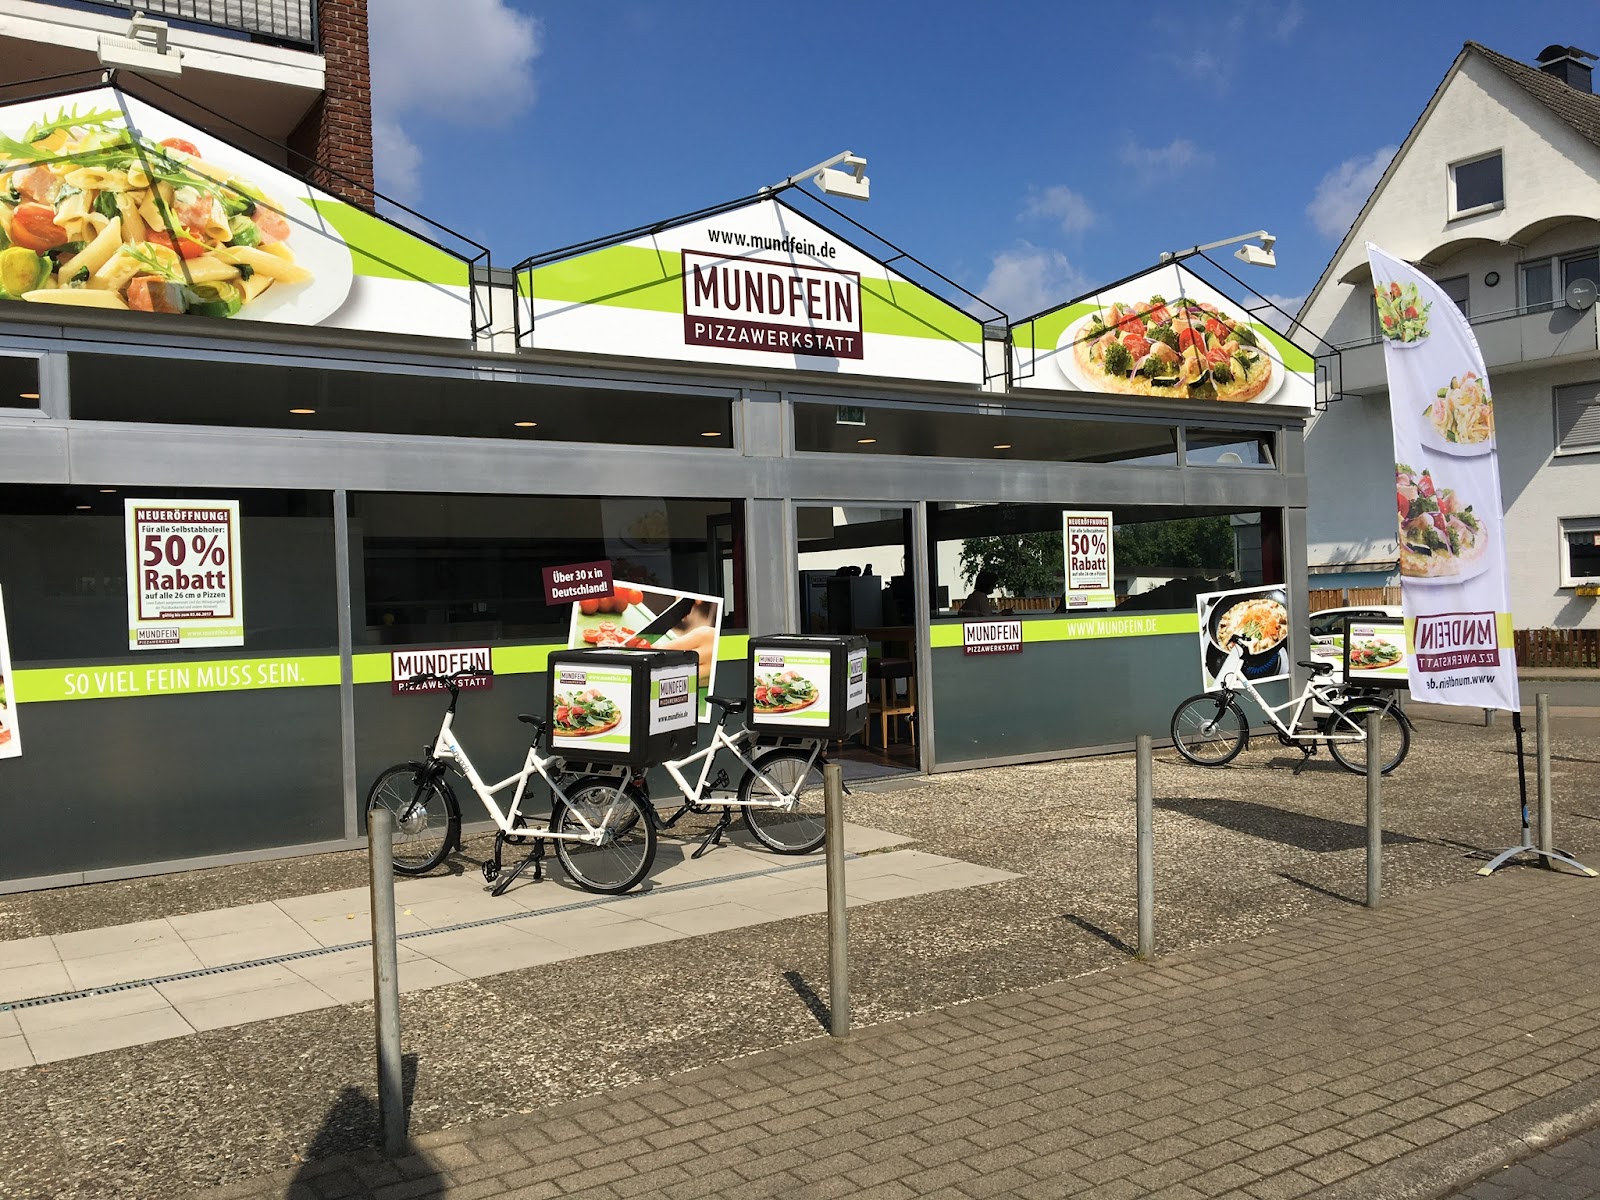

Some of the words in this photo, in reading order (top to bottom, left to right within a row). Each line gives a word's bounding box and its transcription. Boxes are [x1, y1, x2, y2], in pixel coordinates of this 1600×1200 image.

[708, 229, 836, 258] www.mundfein.de
[693, 263, 853, 323] MUNDFEIN
[695, 322, 854, 352] PIZZAWERKSTATT
[138, 509, 228, 521] NEUERÖFFNUNG!
[144, 534, 186, 567] 50
[192, 534, 226, 567] %
[1072, 534, 1089, 555] 50
[1092, 534, 1106, 555] %
[1072, 557, 1106, 570] Rabatt
[145, 569, 226, 590] Rabatt
[553, 570, 574, 583] Über
[575, 570, 586, 580] 30
[588, 570, 593, 579] x
[594, 568, 603, 578] in
[552, 581, 608, 598] Deutschland!
[139, 630, 178, 639] MUNDFEIN
[967, 624, 1019, 642] MUNDFEIN
[1067, 619, 1157, 637] WWW.MUNDFEIN.DE
[967, 644, 1019, 653] PIZZAWERKSTATT
[398, 652, 485, 676] MUNDFEIN
[64, 674, 89, 695] SO
[94, 671, 139, 693] VIEL
[146, 668, 190, 690] FEIN
[197, 665, 251, 688] MUSS
[258, 662, 305, 685] SEIN.
[561, 672, 585, 680] MUNDFEIN
[661, 679, 687, 696] MUNDFEIN
